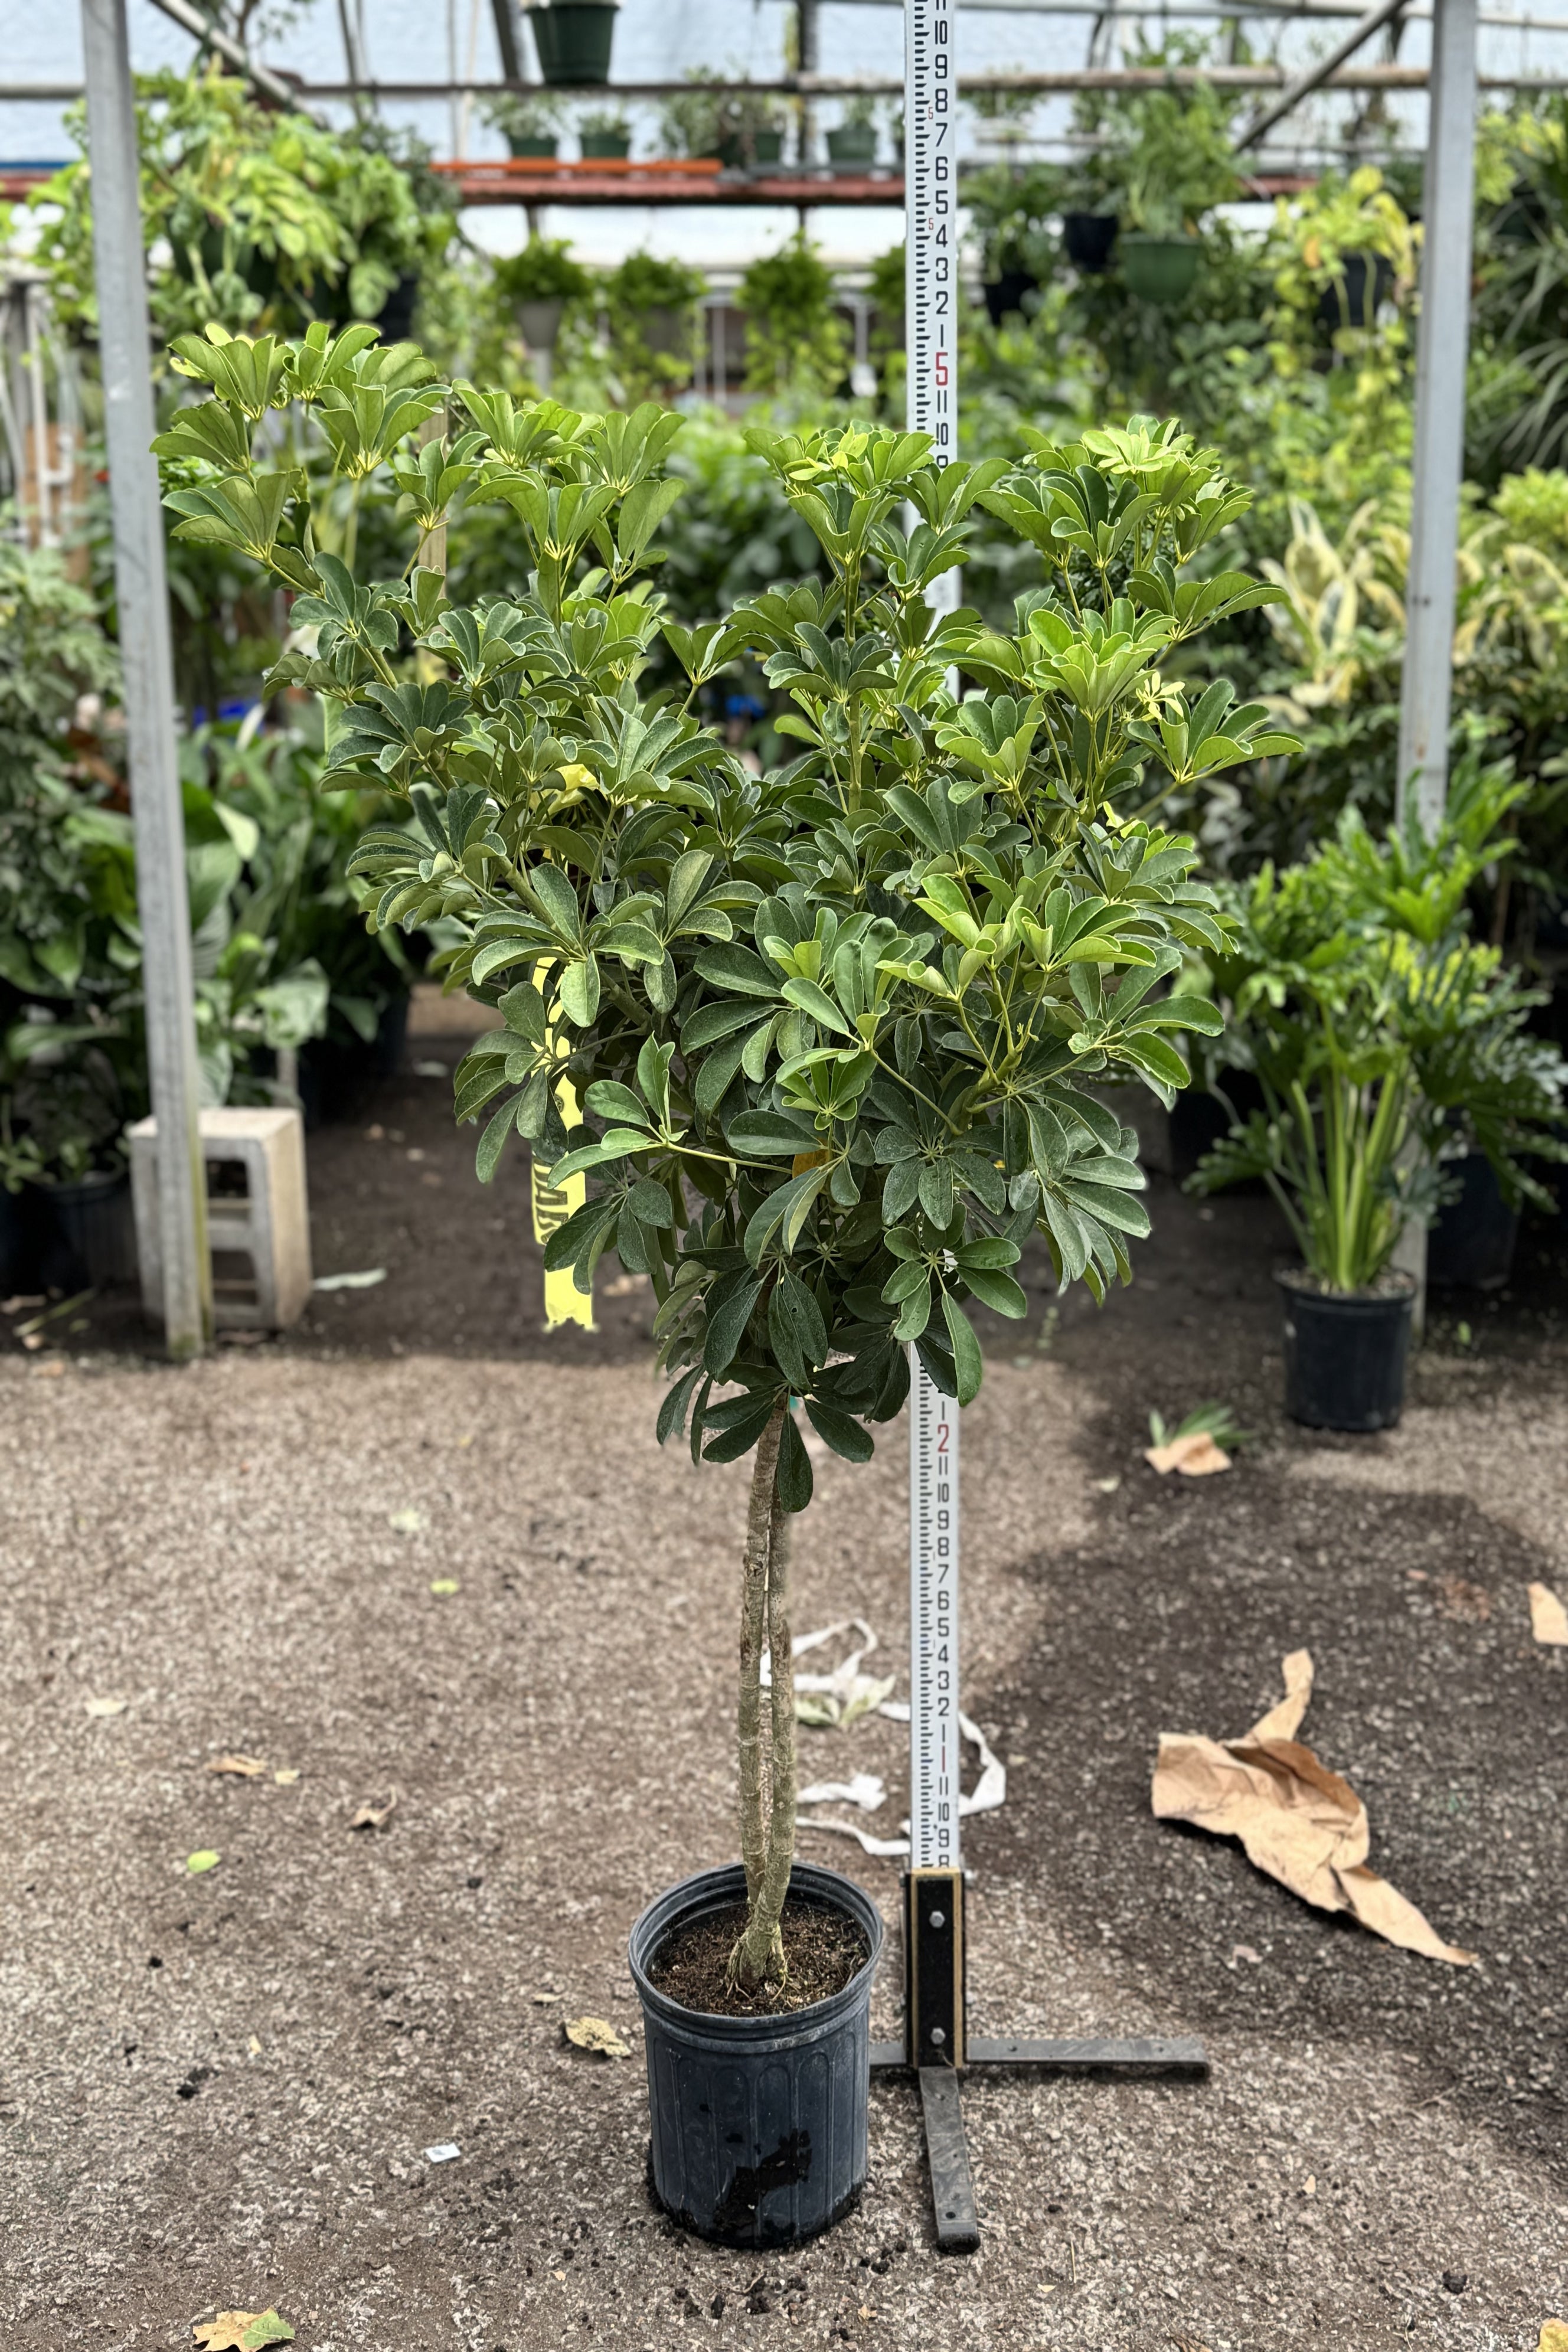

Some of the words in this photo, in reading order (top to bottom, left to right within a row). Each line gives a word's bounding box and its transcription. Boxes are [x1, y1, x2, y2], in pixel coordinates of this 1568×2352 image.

[935, 20, 948, 45] 10
[935, 54, 948, 79] 9
[935, 89, 948, 113] 8
[928, 107, 933, 119] 5
[936, 122, 948, 147] 7
[936, 156, 948, 181] 6
[936, 190, 948, 214] 5
[929, 218, 934, 230] 5
[936, 224, 948, 247] 4
[936, 257, 948, 282] 3
[936, 291, 948, 315] 2
[936, 352, 948, 386] 5
[937, 390, 947, 413] 11
[936, 423, 948, 446] 10
[937, 1424, 949, 1452] 2
[939, 1456, 948, 1475] 11
[937, 1483, 949, 1502] 10
[938, 1510, 949, 1530] 9
[938, 1537, 949, 1556] 8
[938, 1564, 949, 1583] 7
[938, 1590, 949, 1611] 6
[938, 1618, 949, 1637] 5
[938, 1644, 949, 1663] 4
[938, 1671, 949, 1690] 3
[938, 1697, 949, 1716] 2
[939, 1776, 948, 1795] 11
[939, 1802, 949, 1821] 10
[939, 1828, 949, 1847] 9
